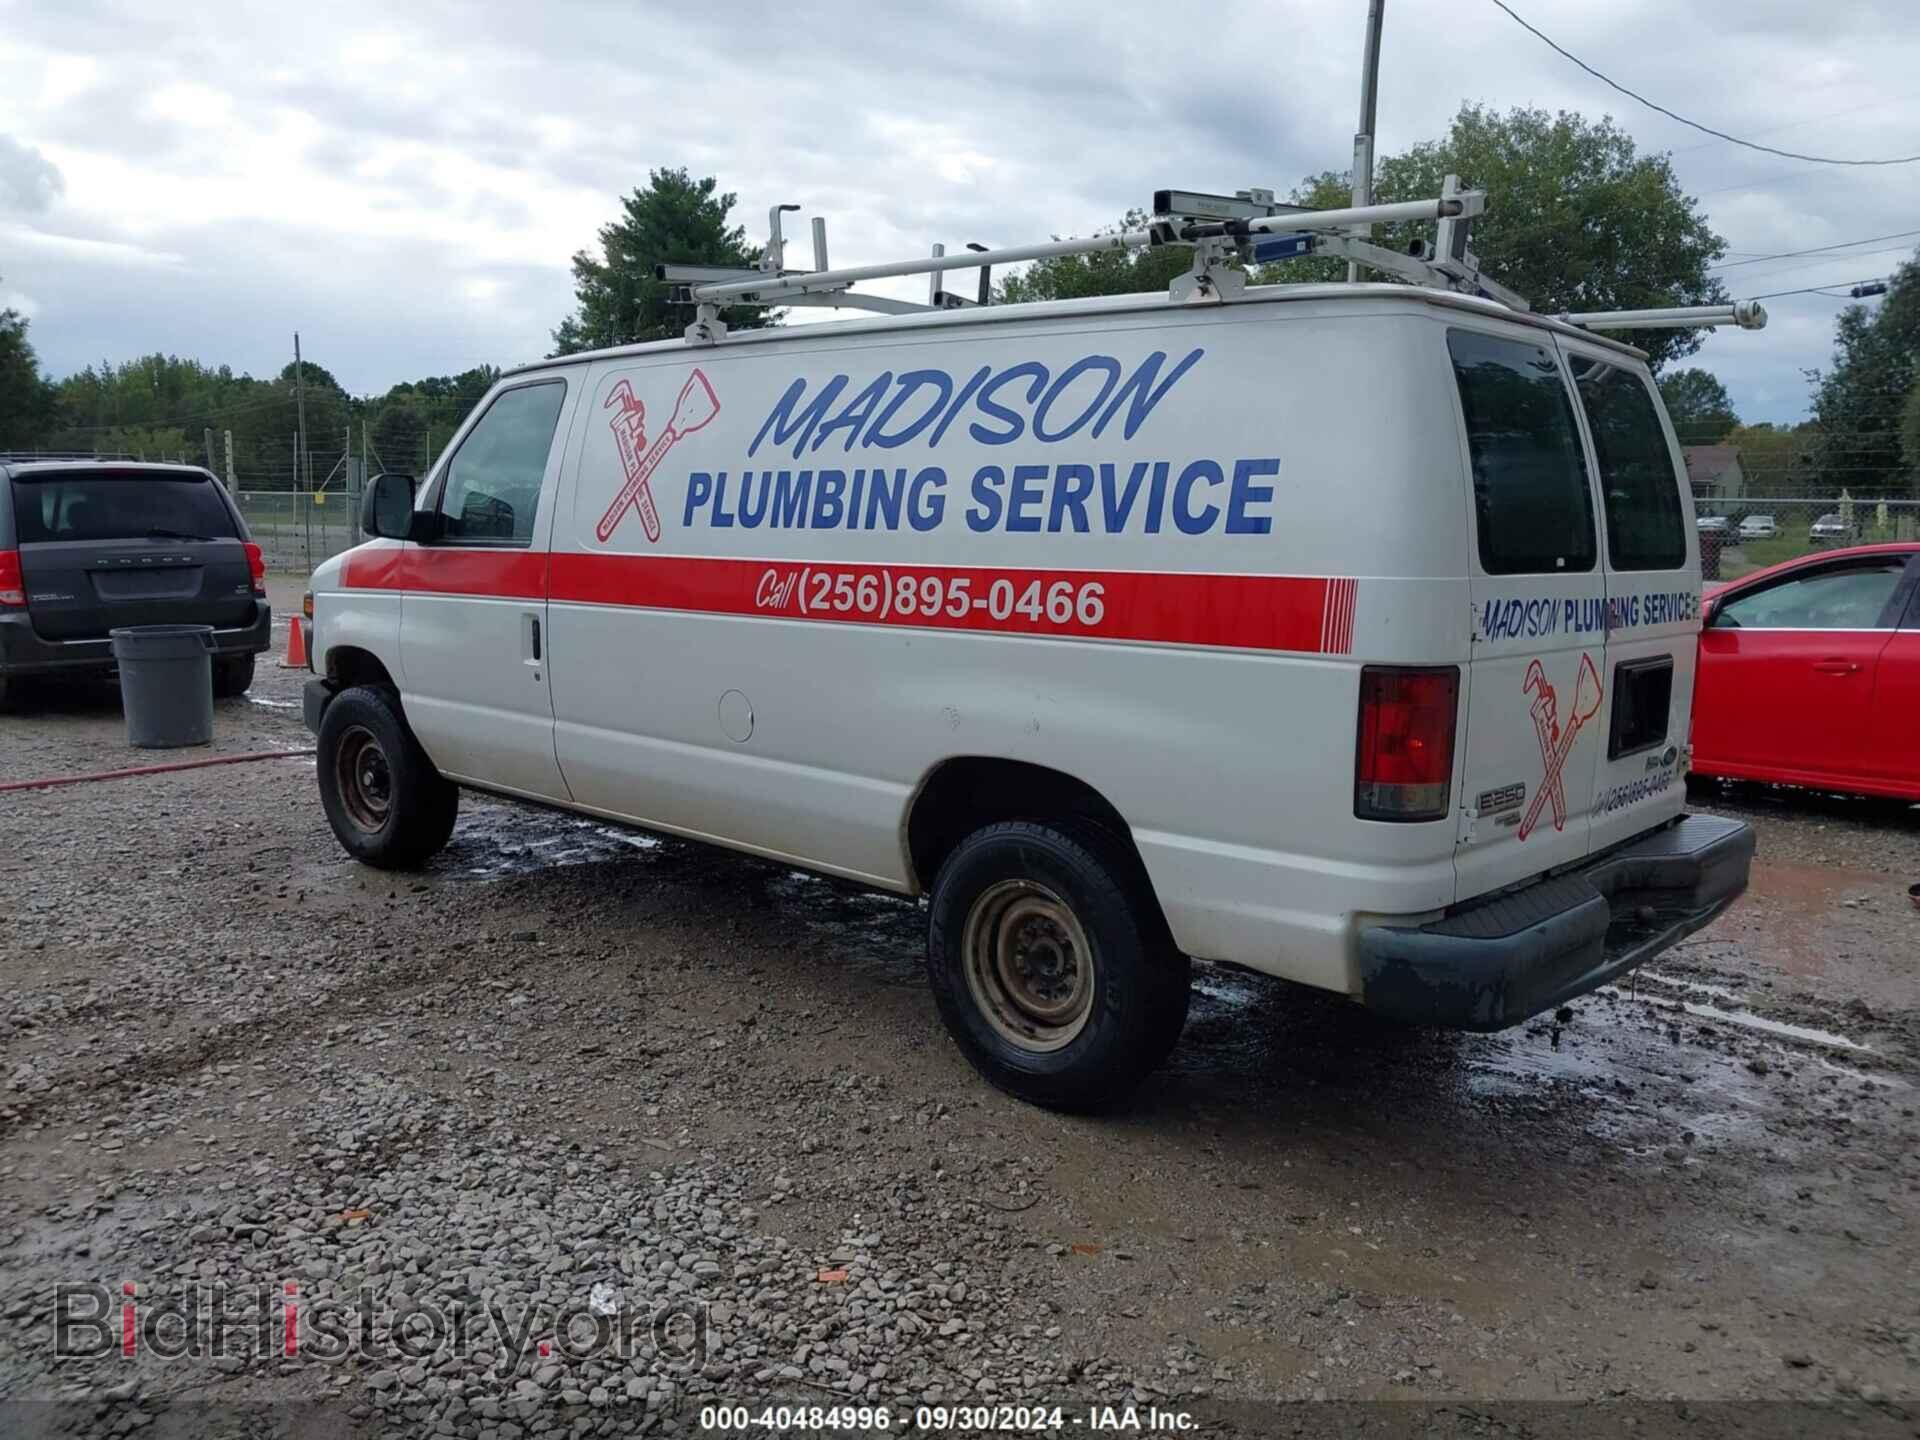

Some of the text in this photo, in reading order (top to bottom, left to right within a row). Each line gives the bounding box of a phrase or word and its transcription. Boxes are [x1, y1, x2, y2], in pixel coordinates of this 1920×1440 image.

[747, 348, 1205, 459] MADISON
[683, 458, 1282, 537] PLUMBING SERVICE
[755, 567, 1106, 626] Call (256)895-0466
[1482, 591, 1692, 643] MADISON PLUMBING SERVICE
